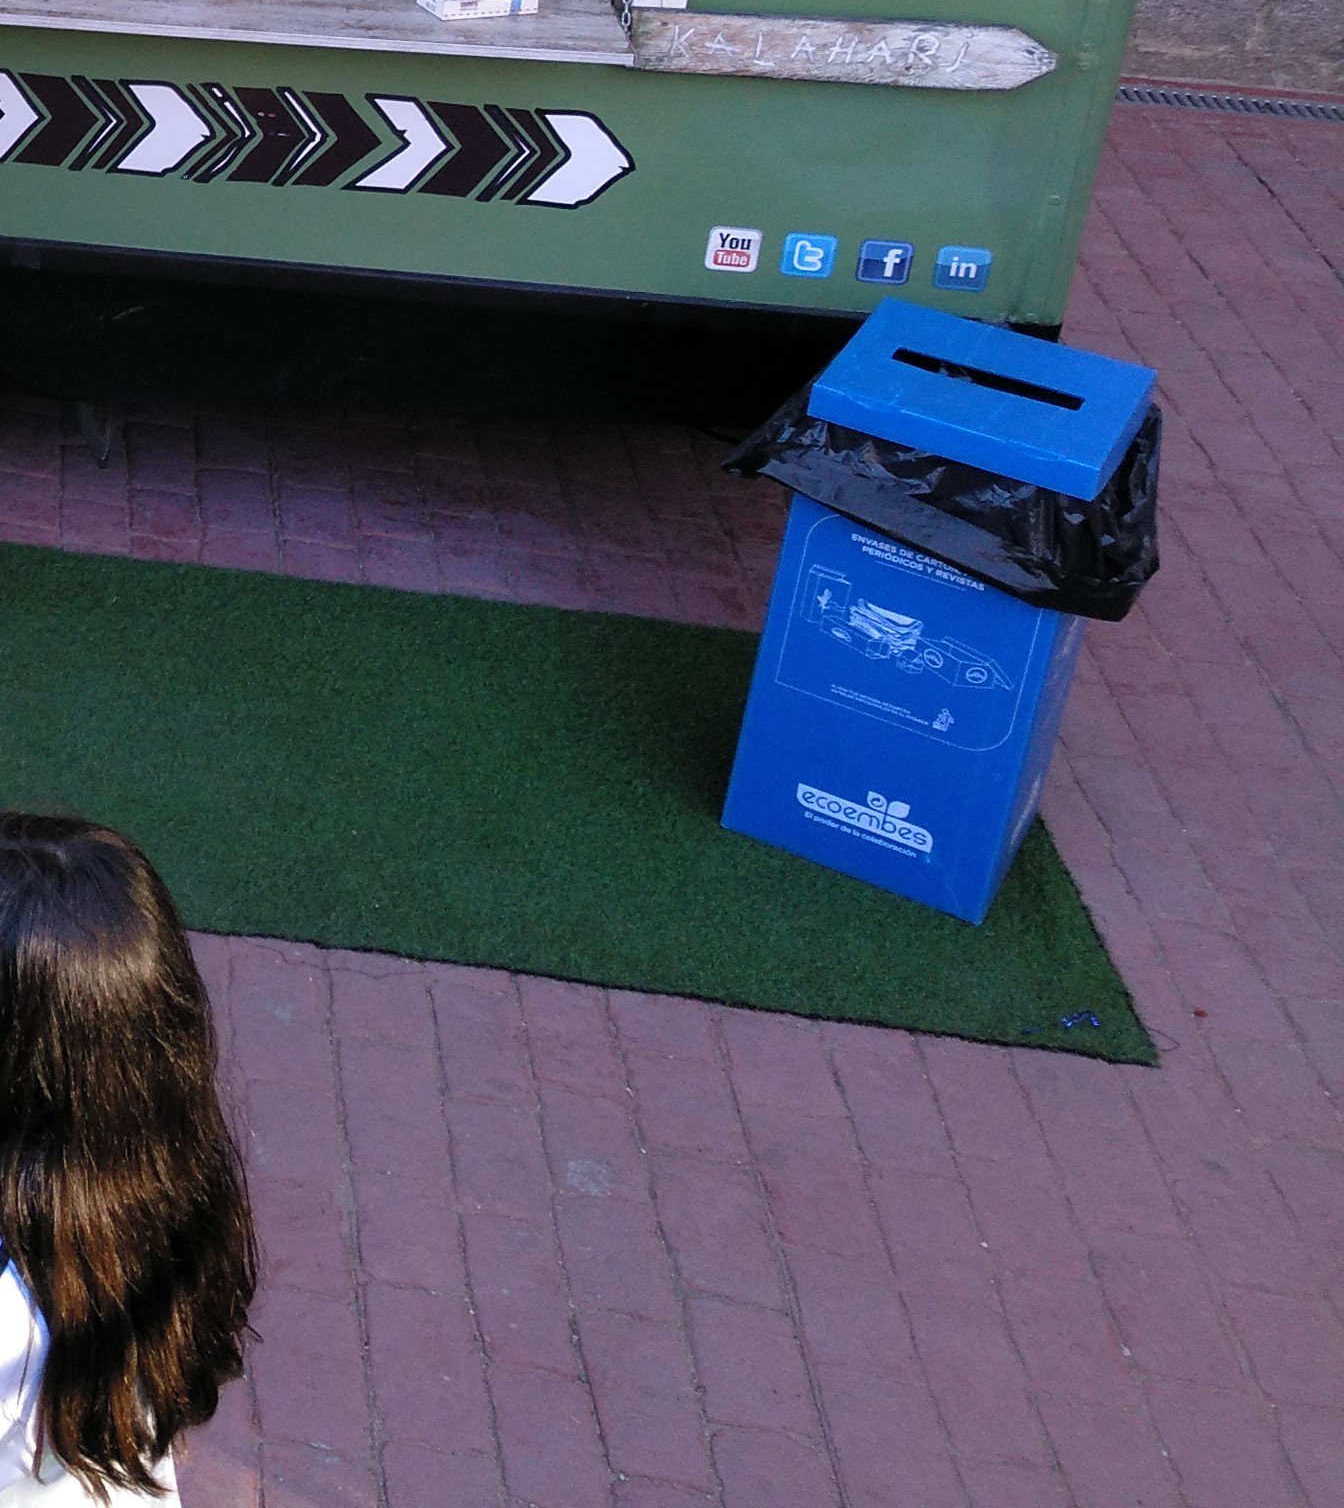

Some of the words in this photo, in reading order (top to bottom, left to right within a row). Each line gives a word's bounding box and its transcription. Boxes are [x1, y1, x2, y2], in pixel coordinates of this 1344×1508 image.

[670, 24, 970, 73] KALAHARI
[718, 232, 752, 251] You
[716, 251, 749, 267] Tube
[949, 257, 977, 279] in
[851, 534, 896, 553] ENVASES
[899, 549, 913, 559] DE
[926, 566, 934, 574] Y
[936, 569, 985, 591] REVISTAS
[802, 791, 927, 845] ecoembes
